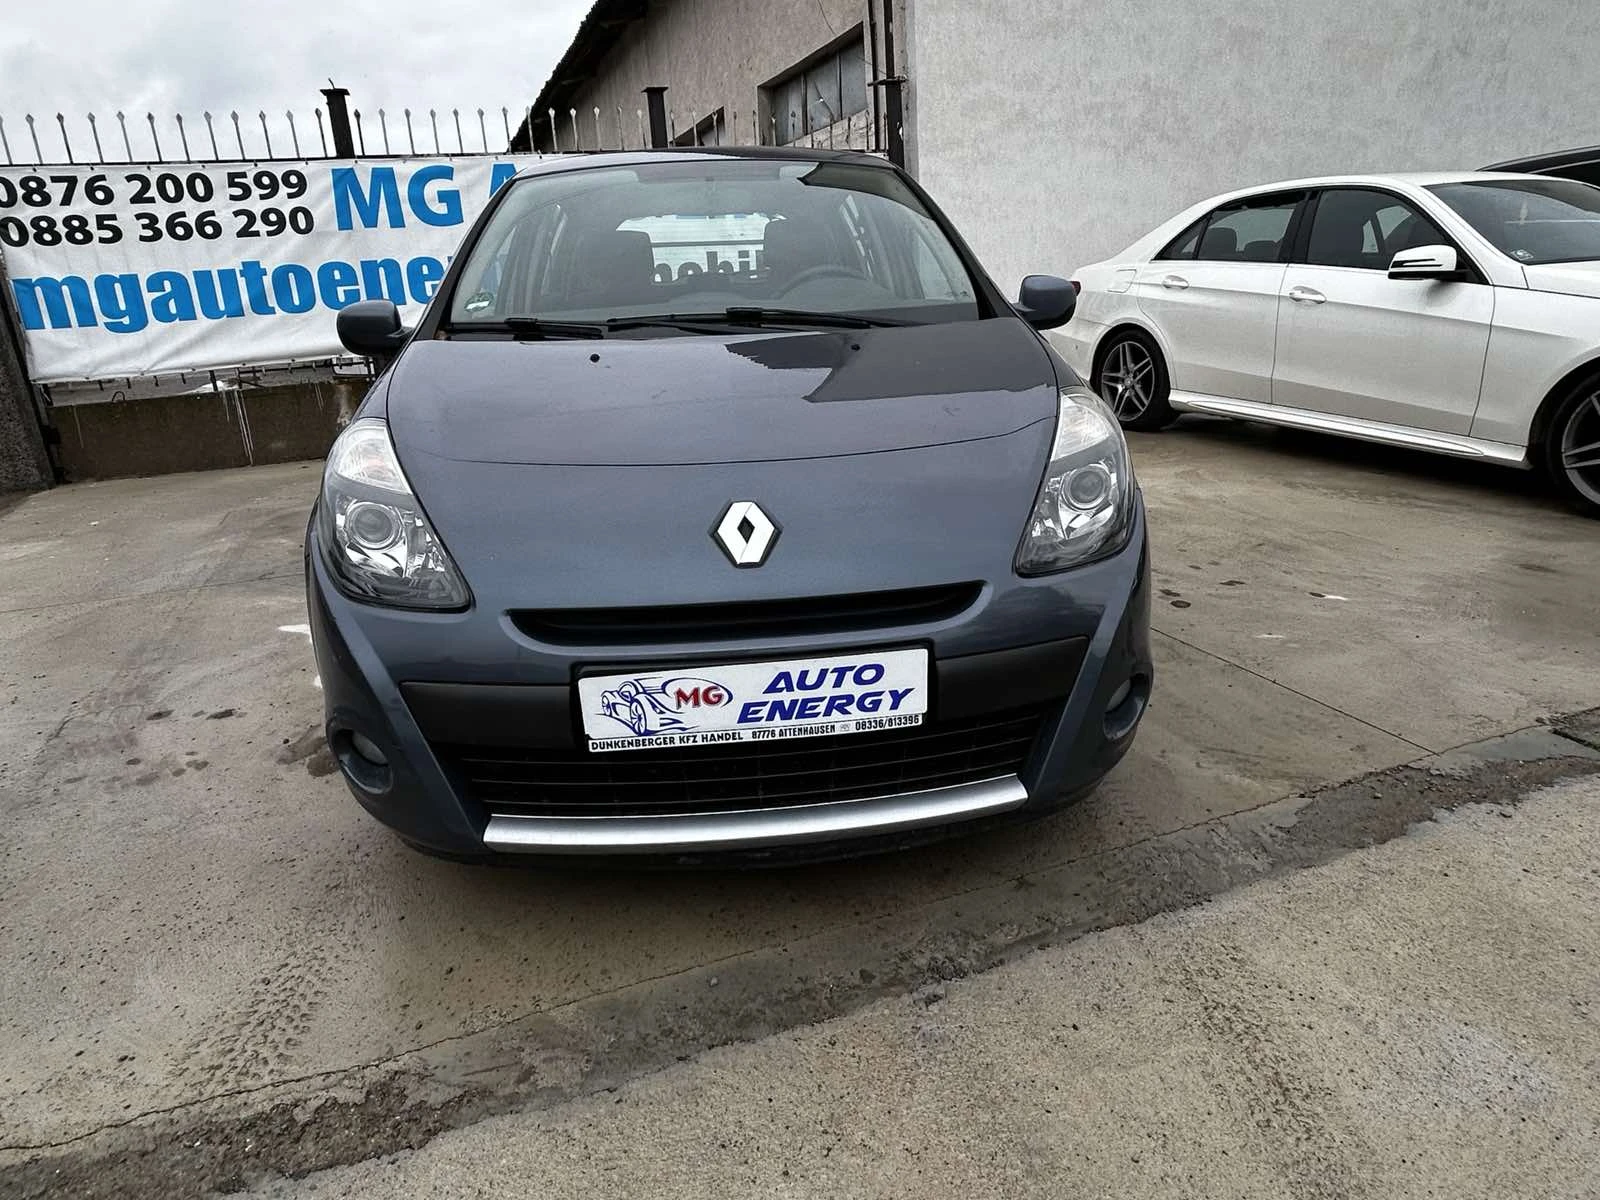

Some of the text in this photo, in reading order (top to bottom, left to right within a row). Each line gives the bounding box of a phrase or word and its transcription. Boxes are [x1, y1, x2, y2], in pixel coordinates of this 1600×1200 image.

[0, 170, 307, 208] 0876 200 599
[331, 164, 464, 231] MG
[0, 206, 314, 248] 0885 366 290
[13, 255, 453, 334] mgautoene
[674, 685, 724, 710] MG
[762, 663, 885, 695] AUTO
[737, 687, 915, 725] ENERGY
[591, 736, 676, 751] DUNKENBERGER
[678, 732, 698, 744] KFZ
[701, 731, 744, 743] HANDEL
[751, 729, 776, 740] 87776
[778, 724, 836, 738] ATTENHAUSEN
